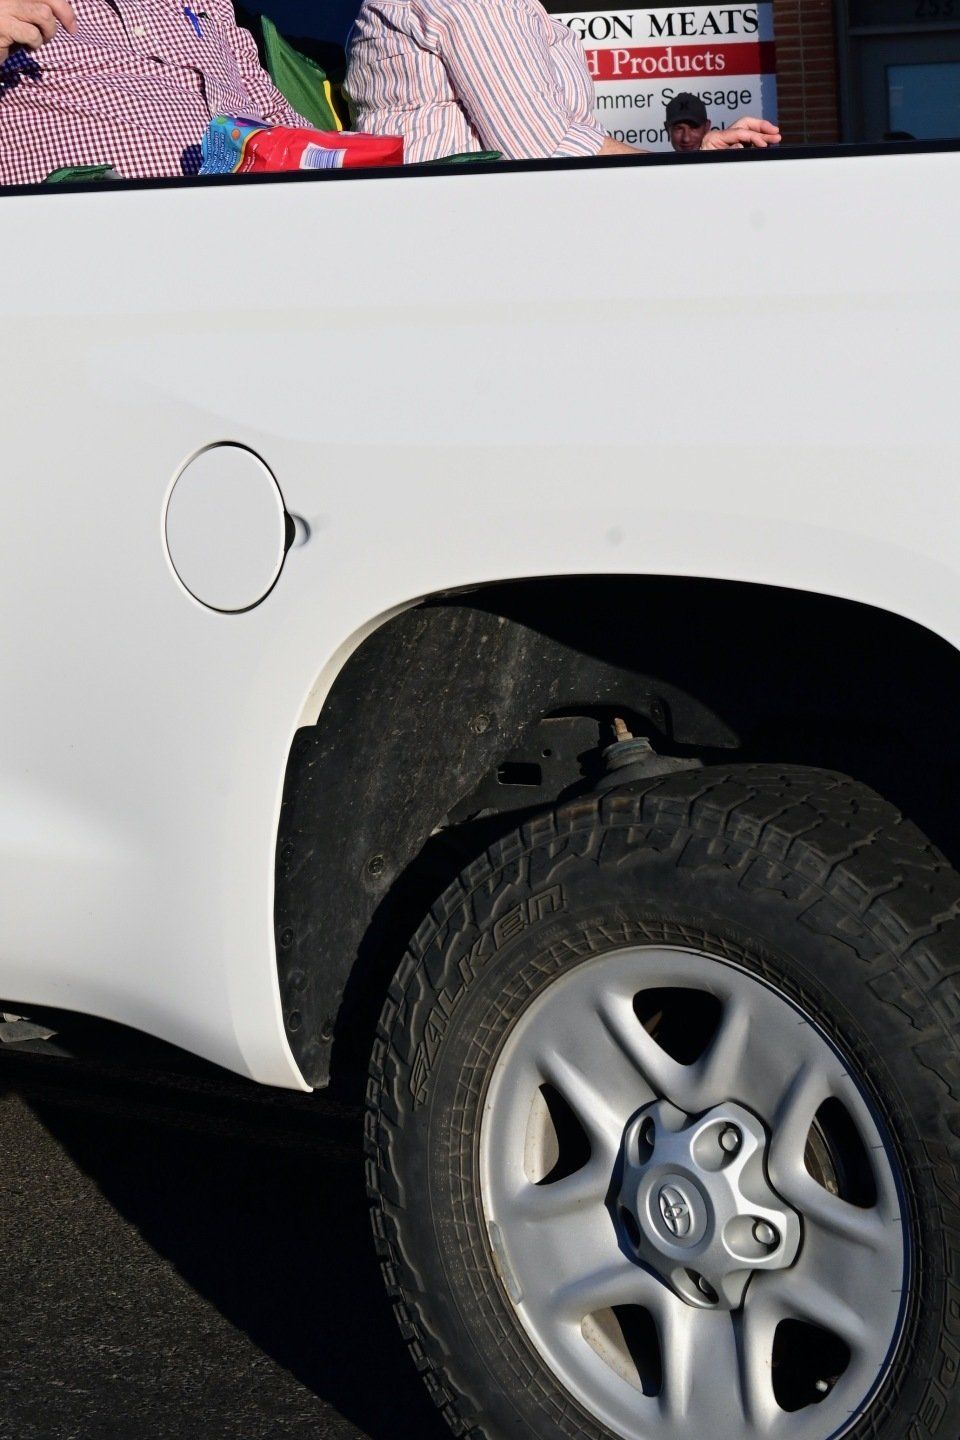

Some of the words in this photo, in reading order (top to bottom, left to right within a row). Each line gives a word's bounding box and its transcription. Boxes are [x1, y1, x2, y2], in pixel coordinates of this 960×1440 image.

[556, 15, 634, 41] GON
[648, 8, 759, 38] MEATS
[610, 46, 726, 76] Products
[596, 92, 654, 110] mmer
[661, 87, 752, 110] Ssage
[606, 127, 671, 144] peron
